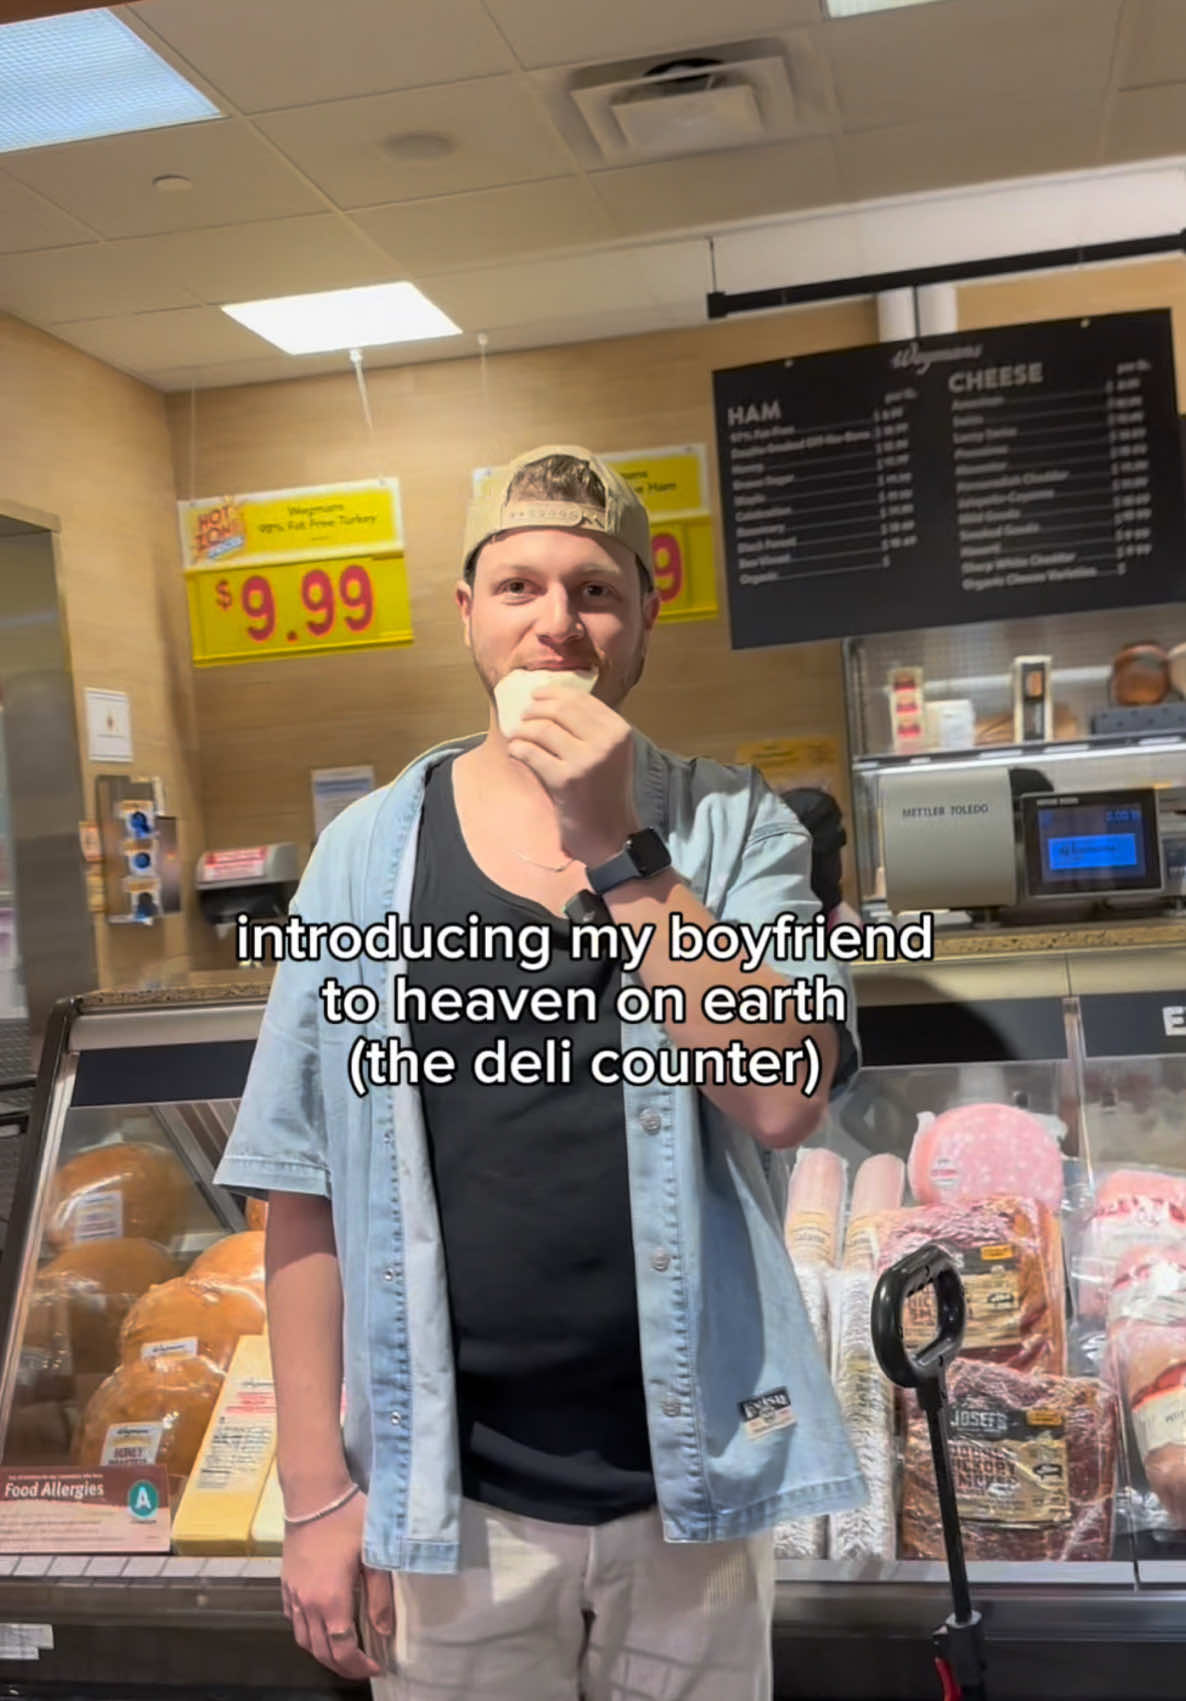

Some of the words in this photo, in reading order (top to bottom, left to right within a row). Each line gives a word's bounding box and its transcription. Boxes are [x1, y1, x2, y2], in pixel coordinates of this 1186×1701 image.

[948, 362, 1044, 393] CHEESE
[728, 400, 781, 426] HAM
[338, 514, 377, 527] Turkey
[902, 807, 945, 816] METTLER
[952, 804, 989, 816] TOLEDO
[5, 1481, 39, 1497] Food
[41, 1480, 104, 1499] Allergies
[134, 1487, 152, 1510] A
